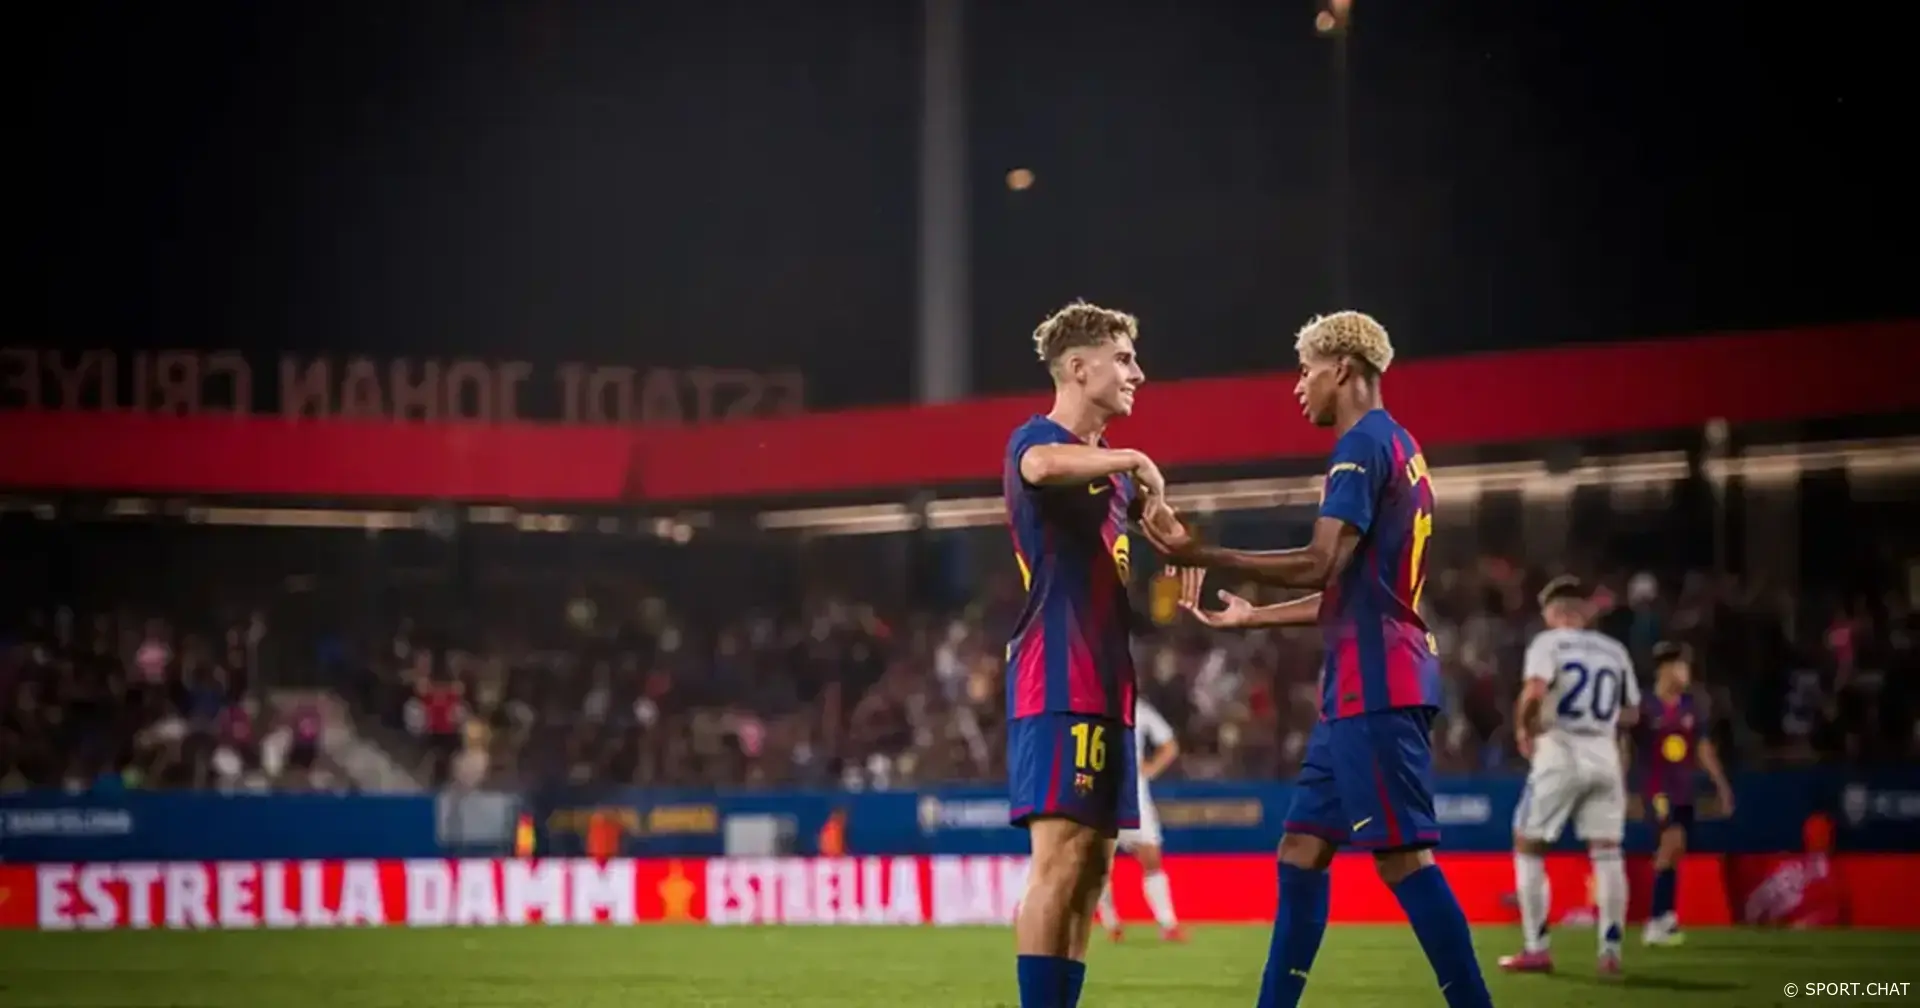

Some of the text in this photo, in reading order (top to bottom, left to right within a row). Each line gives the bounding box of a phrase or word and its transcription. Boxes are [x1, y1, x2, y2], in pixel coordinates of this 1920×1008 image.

[1557, 659, 1618, 721] 20
[1070, 722, 1107, 772] 16
[37, 857, 636, 930] ESTRELLA DAMM
[707, 856, 1031, 925] ESTRELLA DAM
